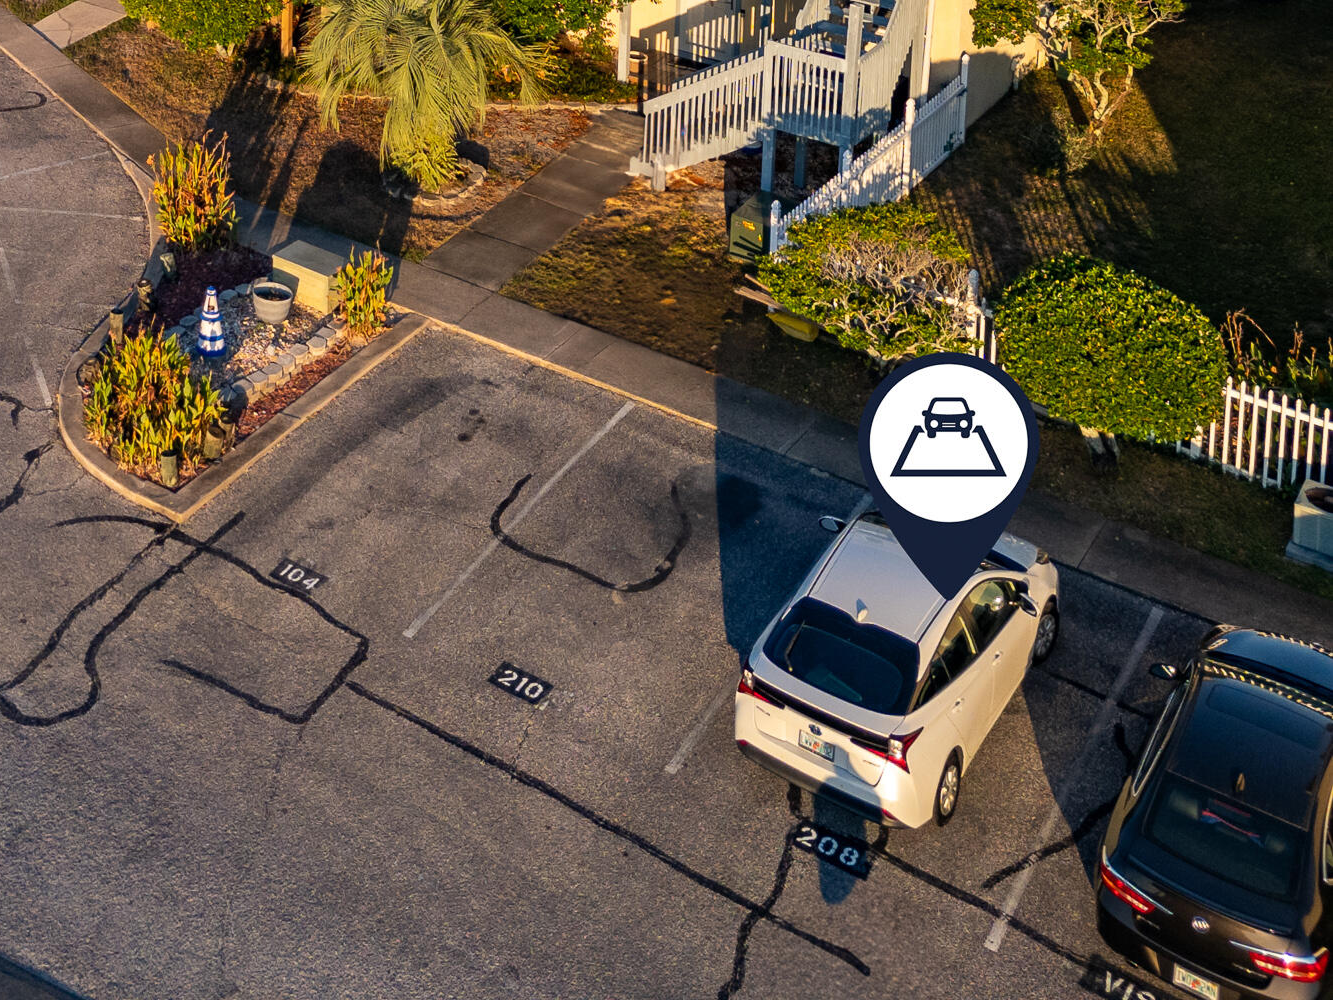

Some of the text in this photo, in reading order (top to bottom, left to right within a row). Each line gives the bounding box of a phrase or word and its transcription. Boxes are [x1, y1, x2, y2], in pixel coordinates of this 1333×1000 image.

[279, 563, 320, 590] 104
[497, 669, 544, 699] 210
[795, 826, 859, 866] 208
